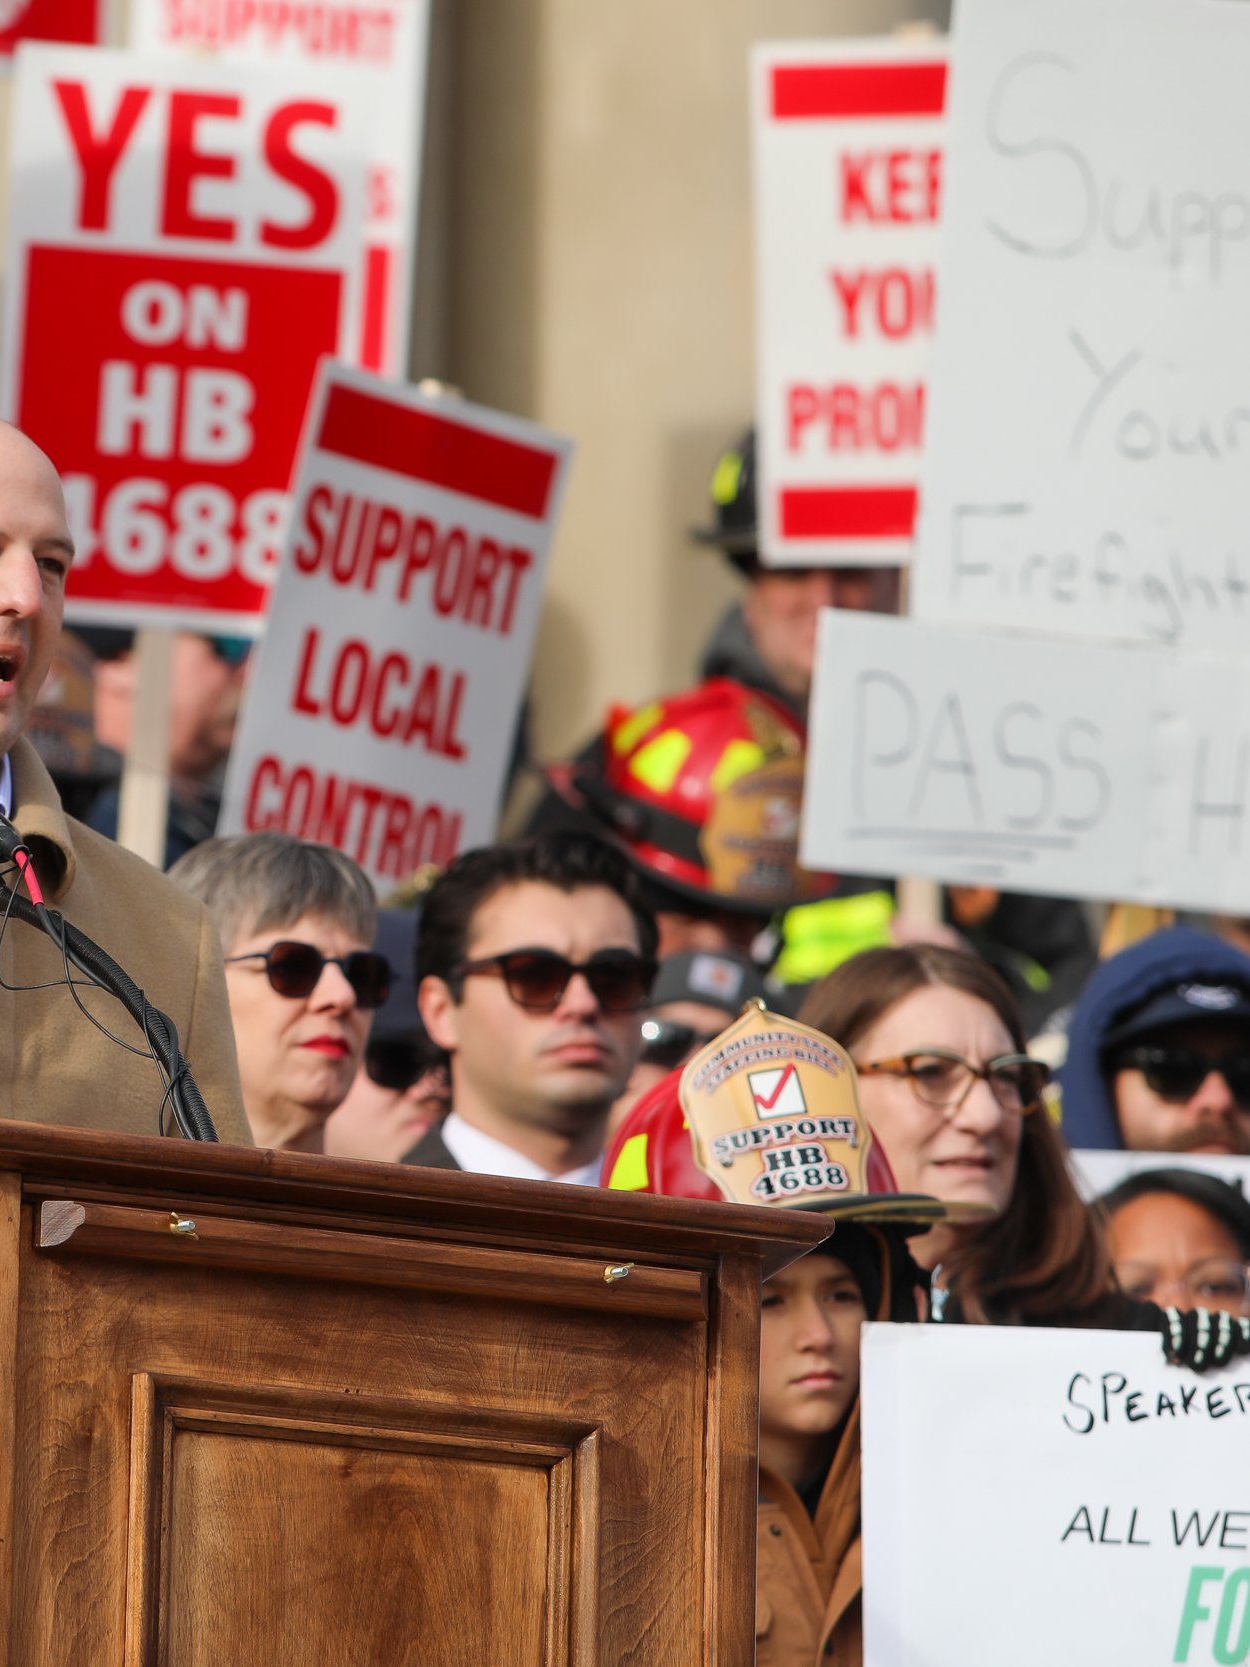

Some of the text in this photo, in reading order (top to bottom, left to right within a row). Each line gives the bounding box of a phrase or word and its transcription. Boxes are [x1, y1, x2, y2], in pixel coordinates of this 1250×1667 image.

[53, 77, 342, 251] YES
[120, 279, 248, 353] ON
[96, 358, 256, 465] HB
[294, 481, 532, 636] SUPPORT
[290, 626, 469, 763] LOCAL
[849, 667, 1114, 832] PASS
[714, 1118, 856, 1156] SUPPORT
[755, 1166, 844, 1196] 4688
[765, 1146, 823, 1171] HB
[1061, 1506, 1250, 1549] ALL WE
